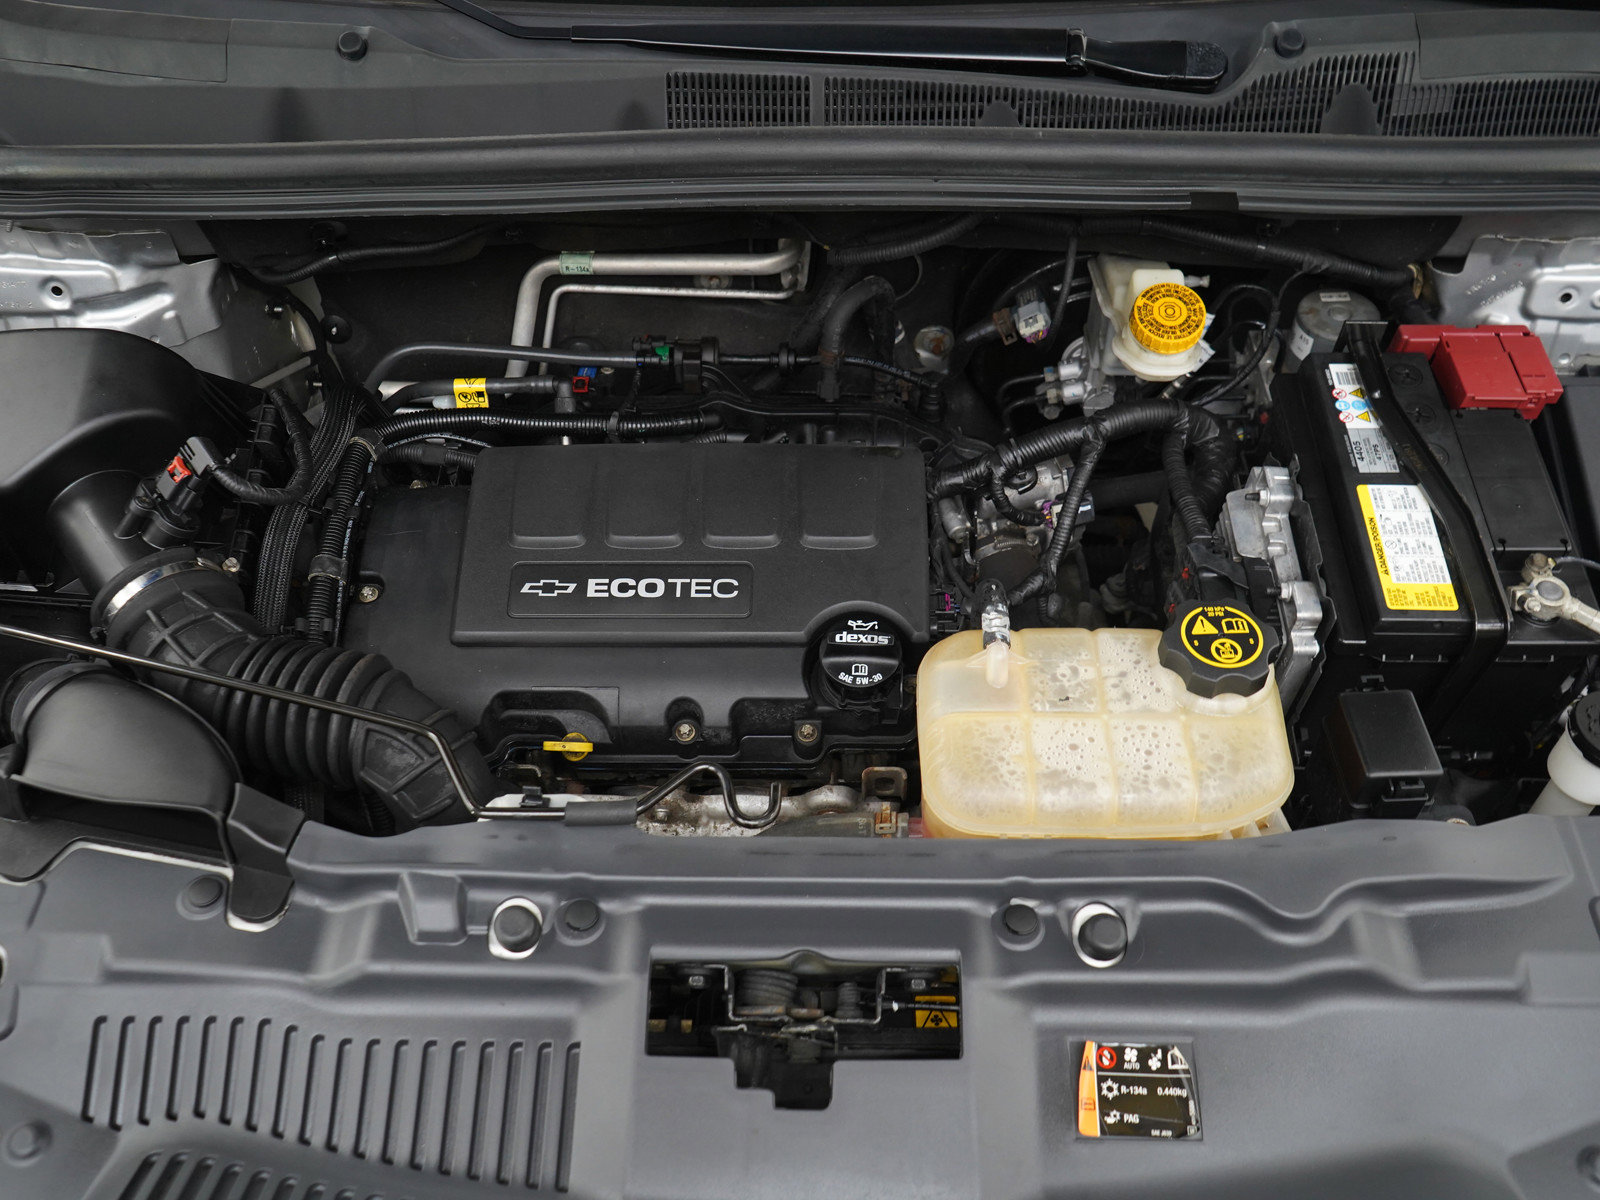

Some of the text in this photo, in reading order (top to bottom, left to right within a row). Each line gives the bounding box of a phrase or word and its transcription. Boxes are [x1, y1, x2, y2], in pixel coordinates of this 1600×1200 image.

[1352, 440, 1364, 462] 4405
[1372, 443, 1382, 461] 47PS
[587, 578, 739, 598] ECOTEC
[835, 631, 889, 645] dexos
[838, 671, 883, 685] SAE 5W-30
[1124, 1062, 1140, 1070] AUTO
[1121, 1085, 1188, 1098] R-134a 0.440kg
[1124, 1113, 1140, 1124] PAG
